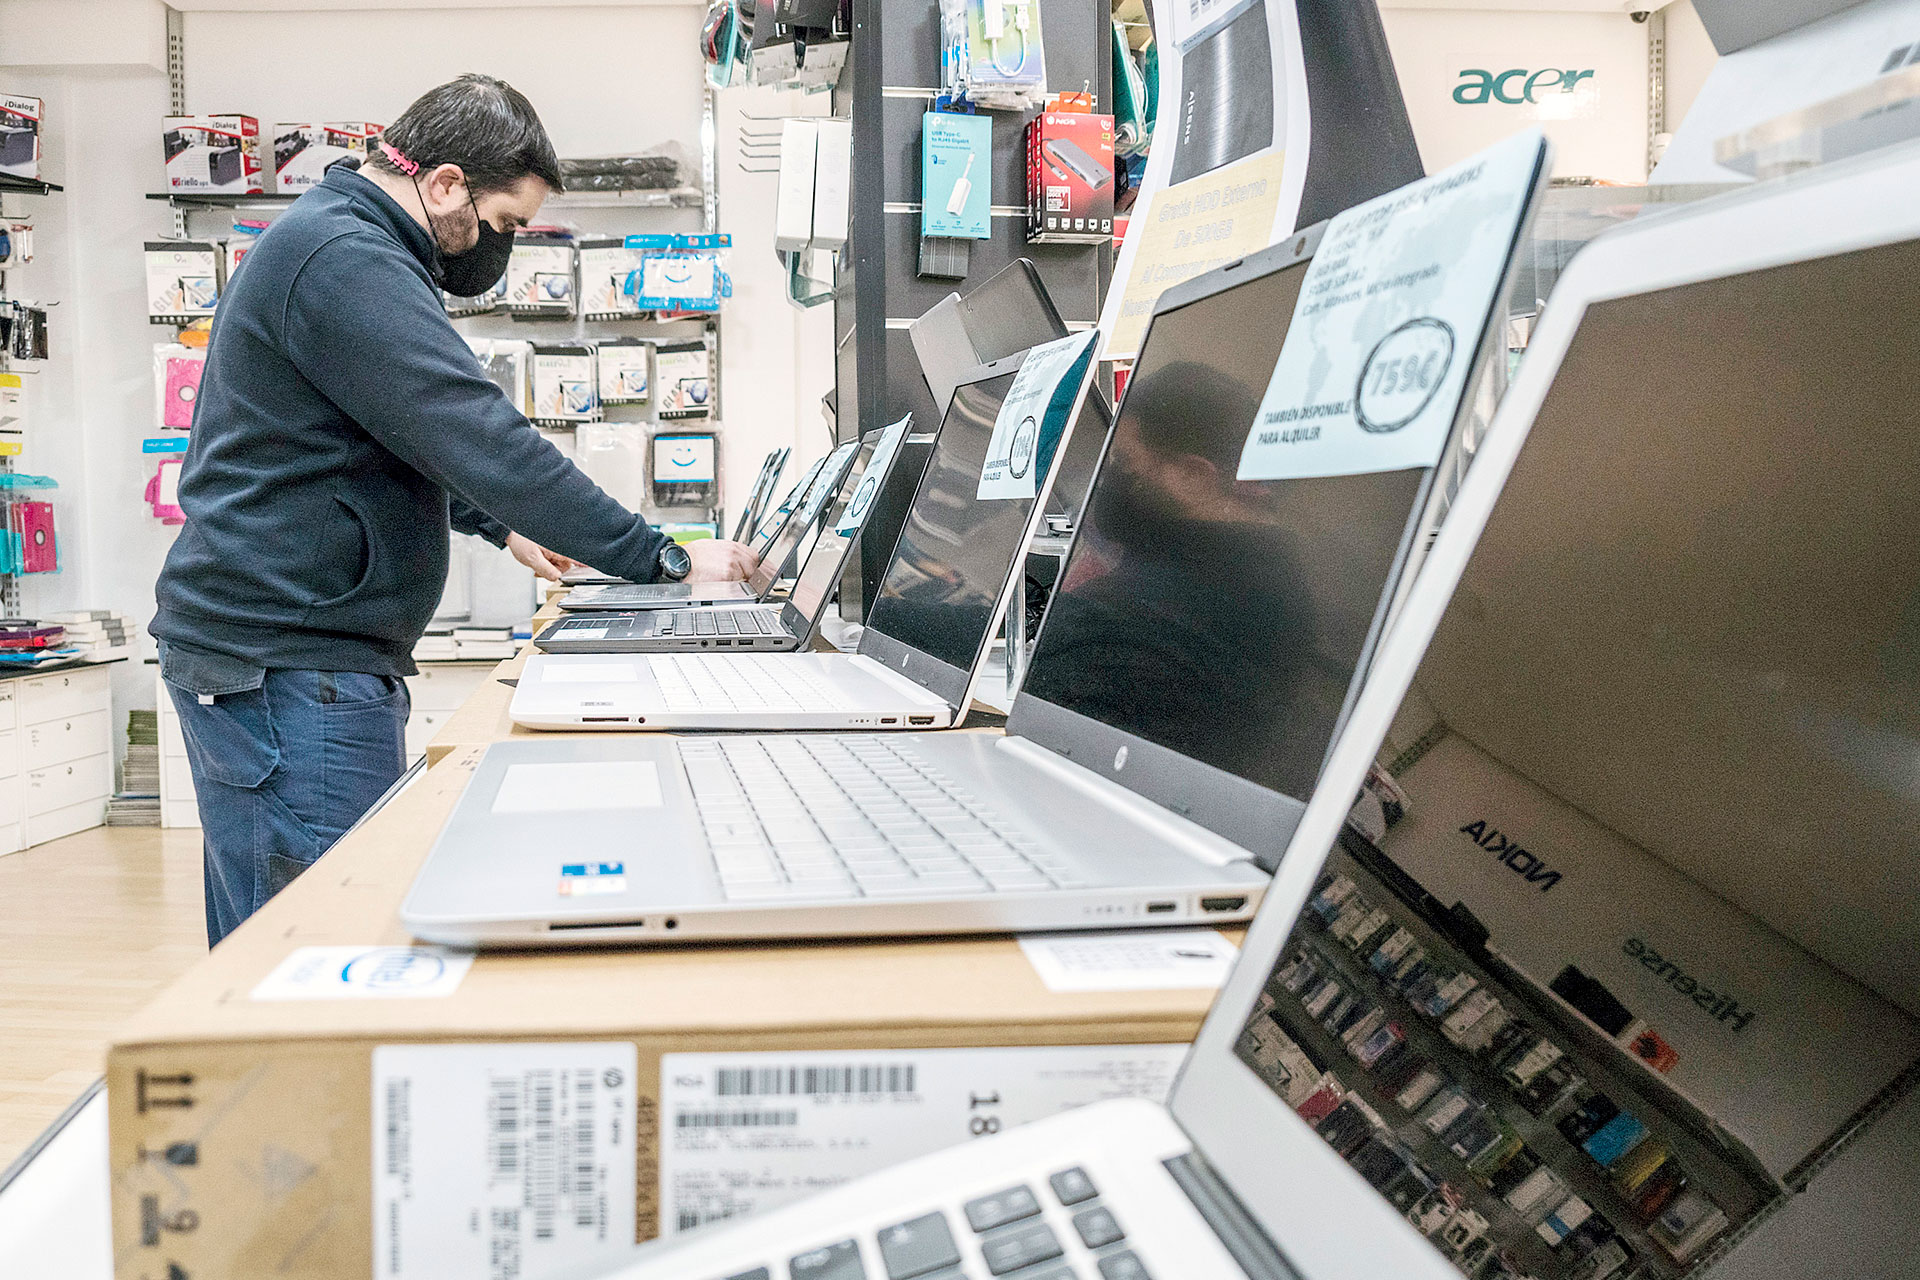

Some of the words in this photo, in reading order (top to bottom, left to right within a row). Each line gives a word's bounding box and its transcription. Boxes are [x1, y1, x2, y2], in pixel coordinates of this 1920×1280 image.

[1452, 68, 1595, 104] acer
[1257, 429, 1279, 446] PARA
[1279, 425, 1321, 445] ALQUILER
